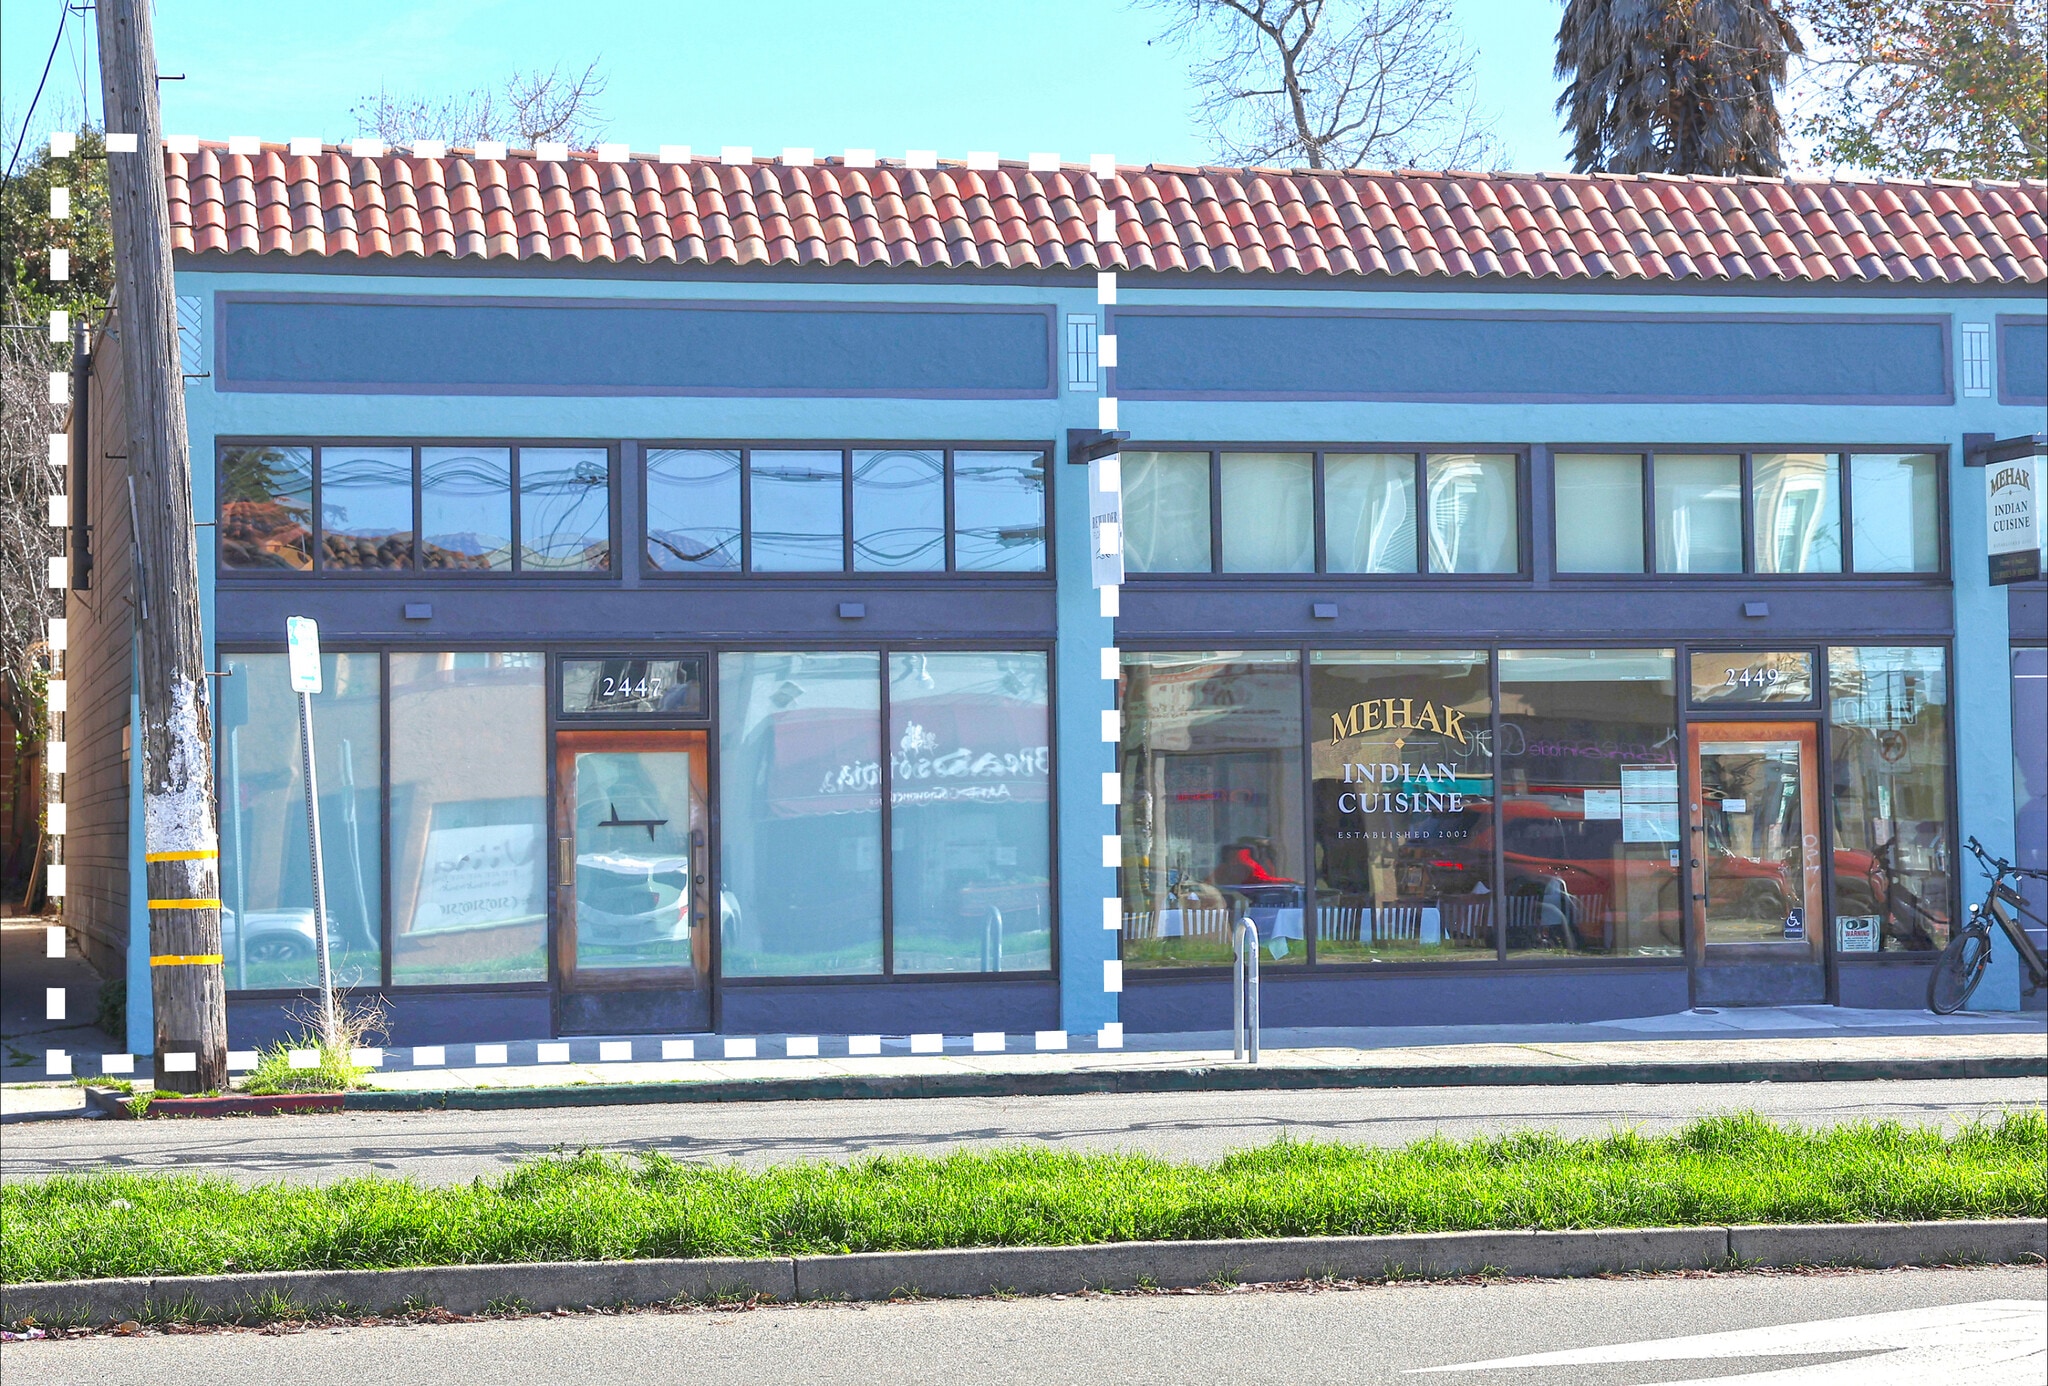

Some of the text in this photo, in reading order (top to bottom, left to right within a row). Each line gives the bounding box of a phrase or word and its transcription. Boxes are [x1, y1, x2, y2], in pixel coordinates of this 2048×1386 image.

[1990, 467, 2031, 497] MEHAK
[1994, 500, 2028, 517] INDIAN
[1993, 516, 2031, 532] CUISINE
[602, 676, 662, 698] 2447
[1725, 667, 1779, 688] 2449
[1331, 697, 1467, 746] MEHAK
[1842, 699, 1914, 725] OPEN
[1342, 762, 1458, 784] INDIAN
[1338, 791, 1465, 814] CUISINE
[1338, 829, 1468, 839] ESTABLISHED 2002
